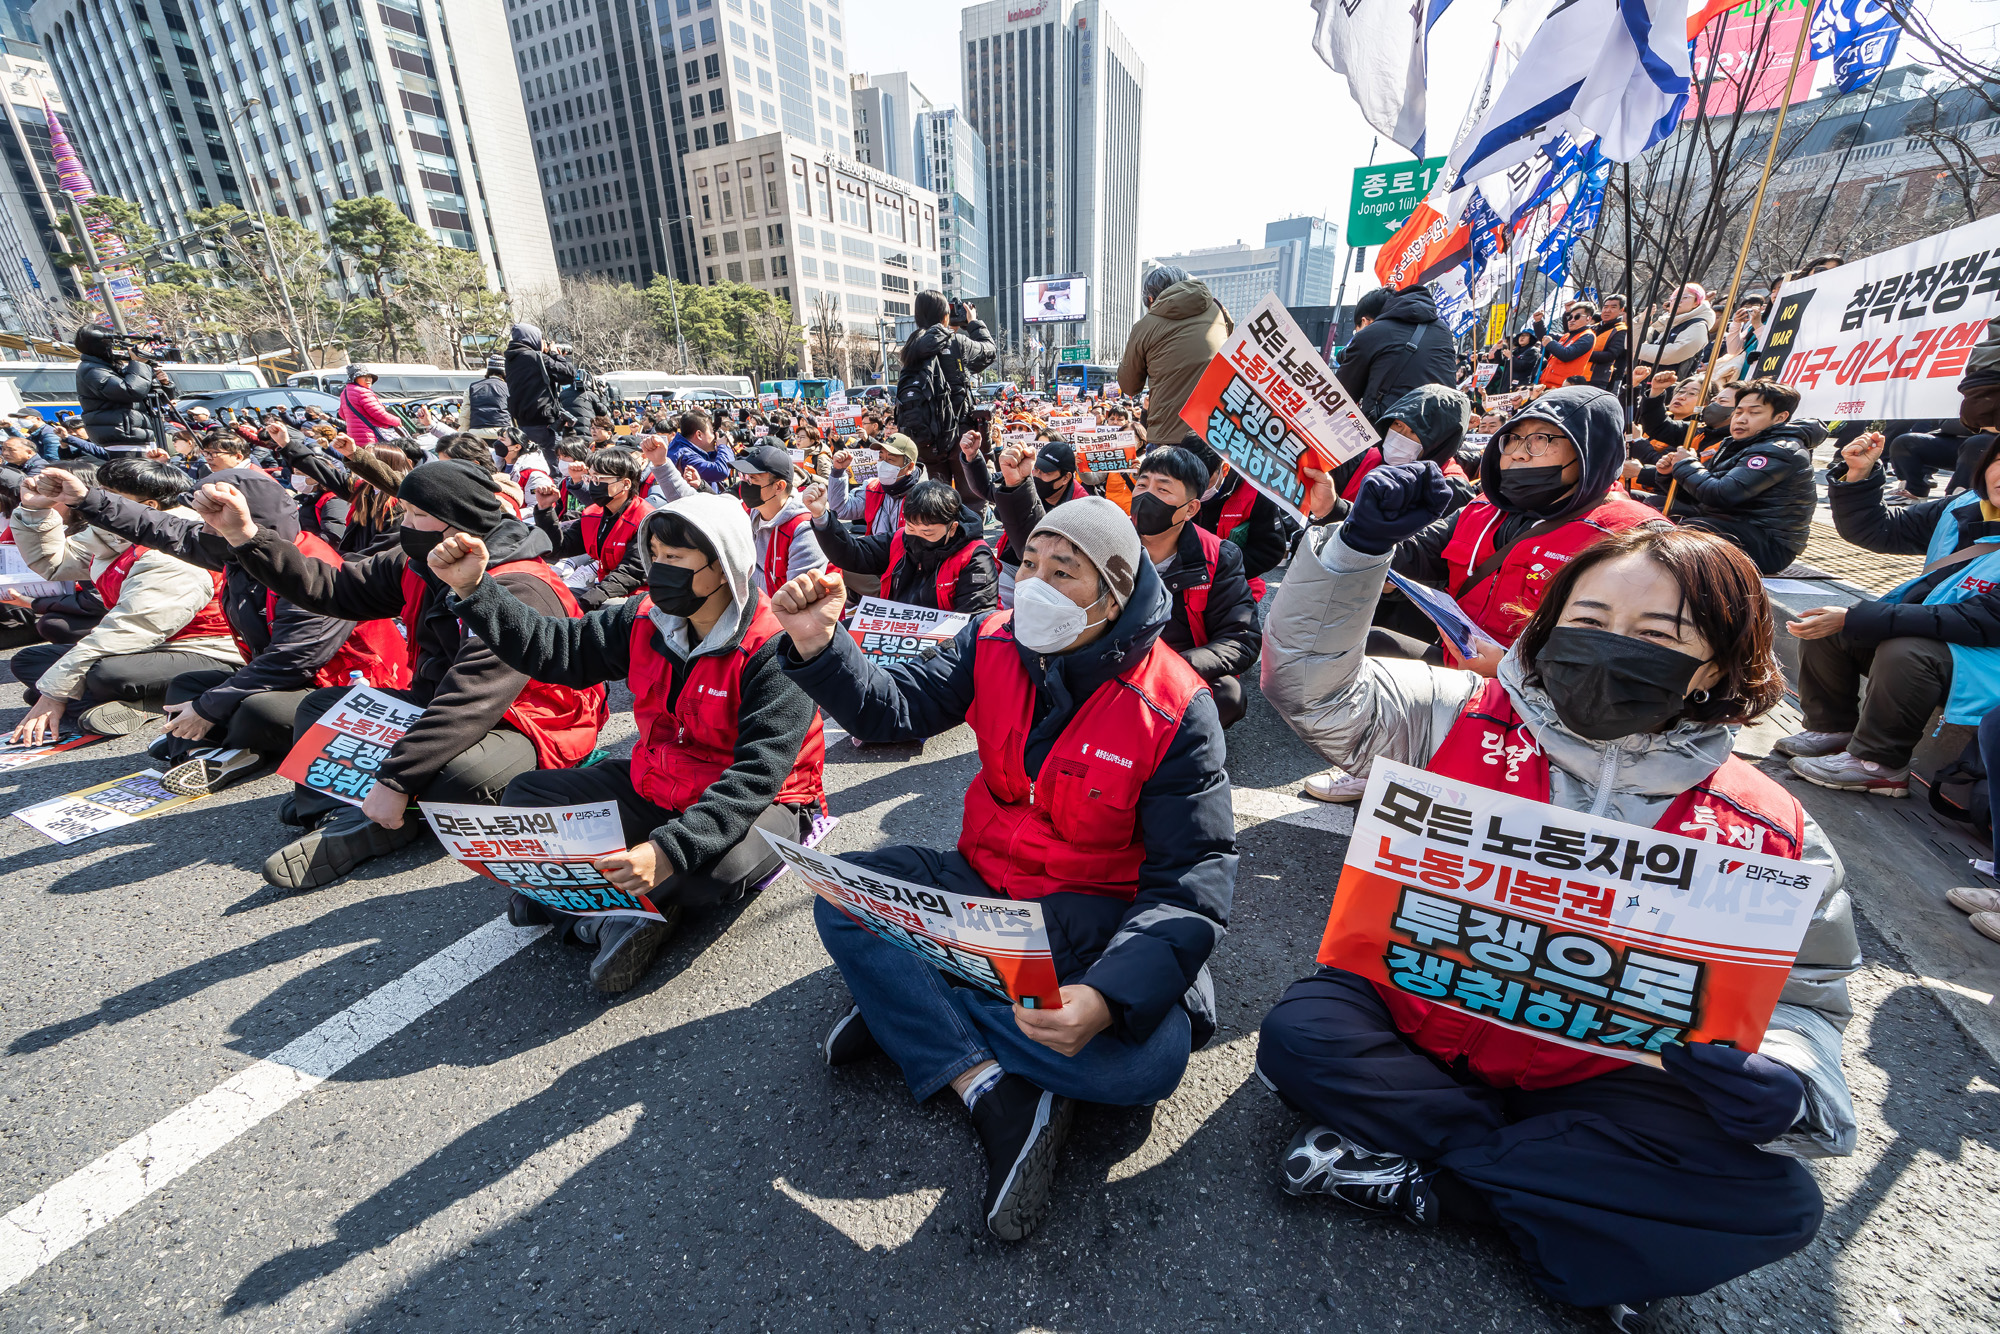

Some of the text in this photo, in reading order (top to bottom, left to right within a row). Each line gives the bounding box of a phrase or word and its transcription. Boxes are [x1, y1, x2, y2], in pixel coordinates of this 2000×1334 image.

[1008, 5, 1041, 22] kobaco
[1361, 168, 1439, 198] 종로1
[1357, 201, 1395, 217] Jongno
[1780, 303, 1799, 322] NO
[1769, 329, 1794, 347] WAR
[1247, 309, 1347, 417] 모든 노동자의
[1762, 356, 1779, 372] ON
[1230, 340, 1307, 418] 노동기본권
[1050, 417, 1083, 427] 모든 노동자의
[1221, 374, 1308, 468] 투쟁으로
[1351, 418, 1372, 442] 민주노총
[1091, 433, 1117, 441] 노동자의
[1080, 443, 1111, 451] 노동기본권
[1086, 449, 1126, 461] 투쟁으로
[1088, 460, 1132, 472] 쟁취하자!
[1207, 410, 1305, 504] 쟁취하자!
[1956, 576, 1999, 594] 보당
[860, 602, 939, 622] 모든 노동자의
[858, 618, 919, 634] 노동기본권
[1053, 622, 1071, 633] KF94
[344, 692, 388, 720] 모든
[575, 808, 611, 821] 민주노총
[432, 812, 559, 837] 모든 노동자의
[1373, 782, 1474, 849] 모든
[1482, 816, 1698, 891] 노동자의
[452, 839, 550, 858] 노동기본권
[483, 861, 610, 886] 투쟁으로
[775, 841, 953, 918] 모든 노동자의
[1375, 835, 1617, 928] 노동기본권
[1745, 864, 1811, 891] 민주노총
[979, 904, 1032, 918] 민주노총
[1396, 889, 1698, 1026] 투쟁으로
[1386, 944, 1692, 1053] 쟁취하자
